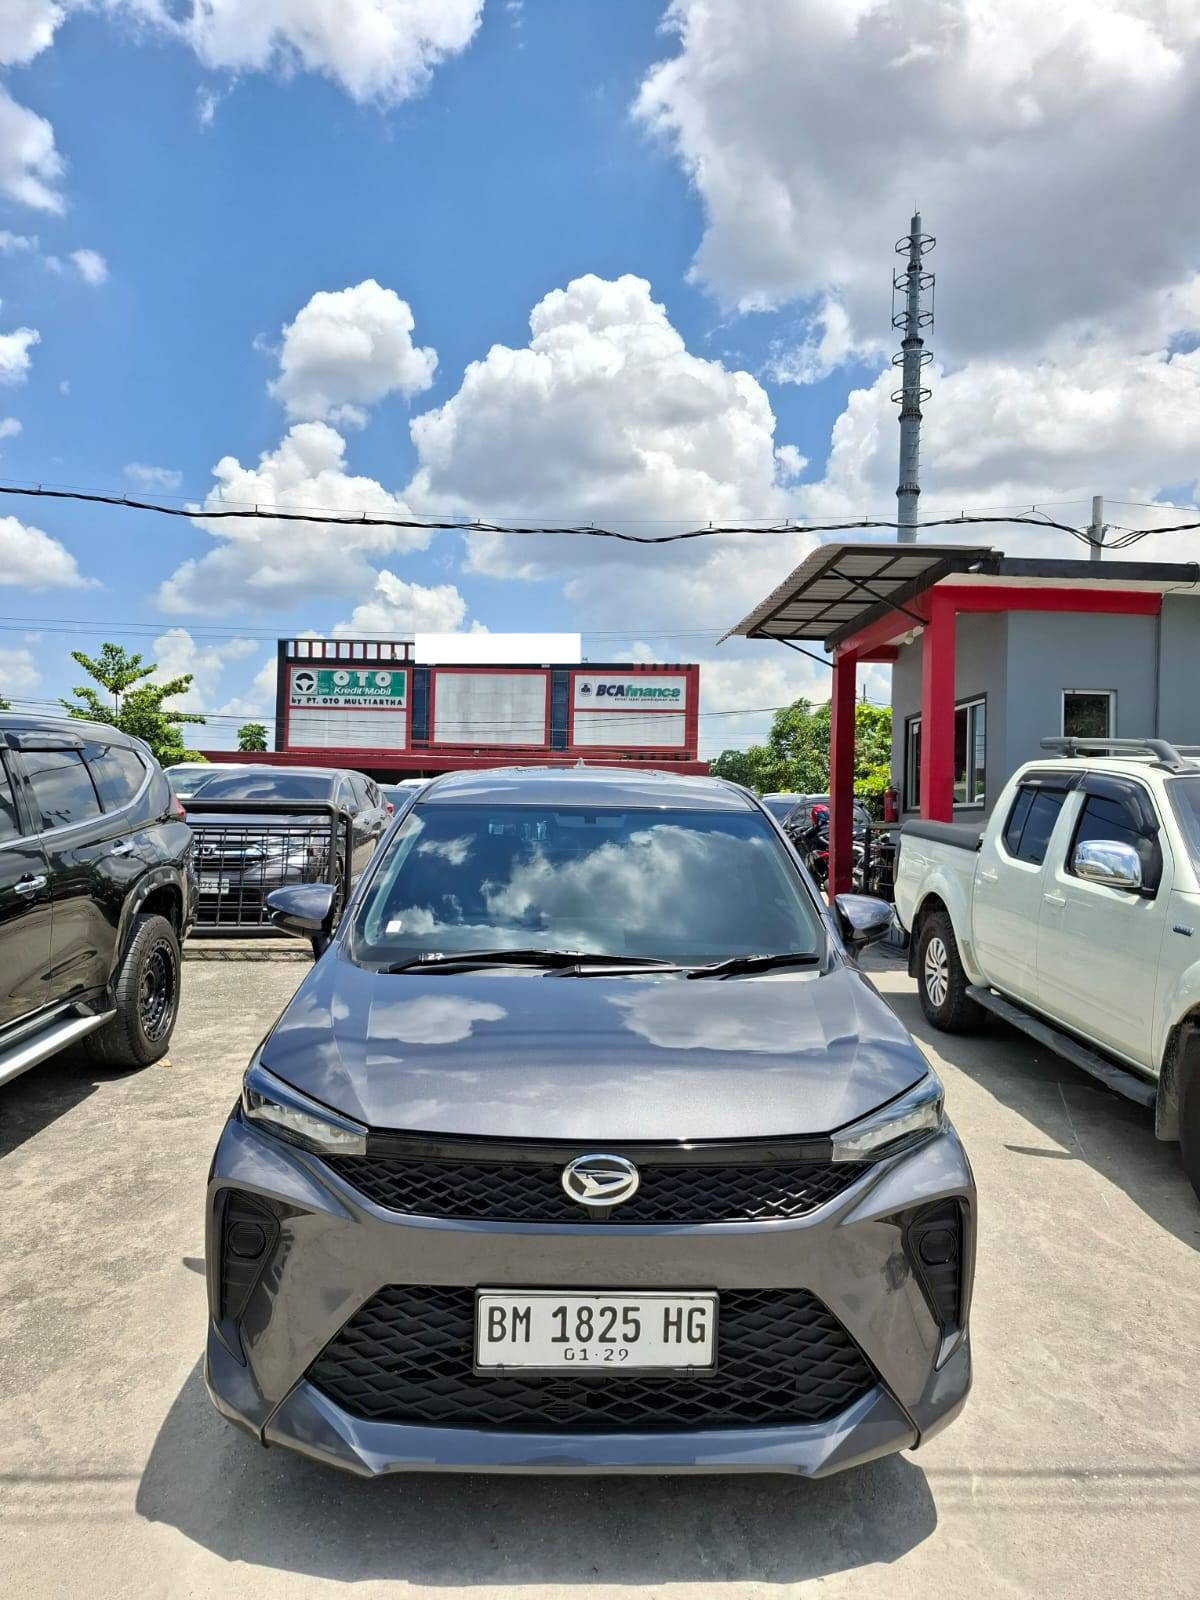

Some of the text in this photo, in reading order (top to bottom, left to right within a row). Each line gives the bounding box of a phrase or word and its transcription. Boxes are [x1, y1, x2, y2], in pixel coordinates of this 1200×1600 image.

[333, 671, 392, 687] OTO
[333, 686, 362, 695] Kredit
[364, 687, 392, 696] Mobil
[596, 684, 681, 698] BCAfinance
[291, 697, 403, 706] by PT. OTO MULTIARTHA
[487, 1305, 706, 1344] BM 1825 HG
